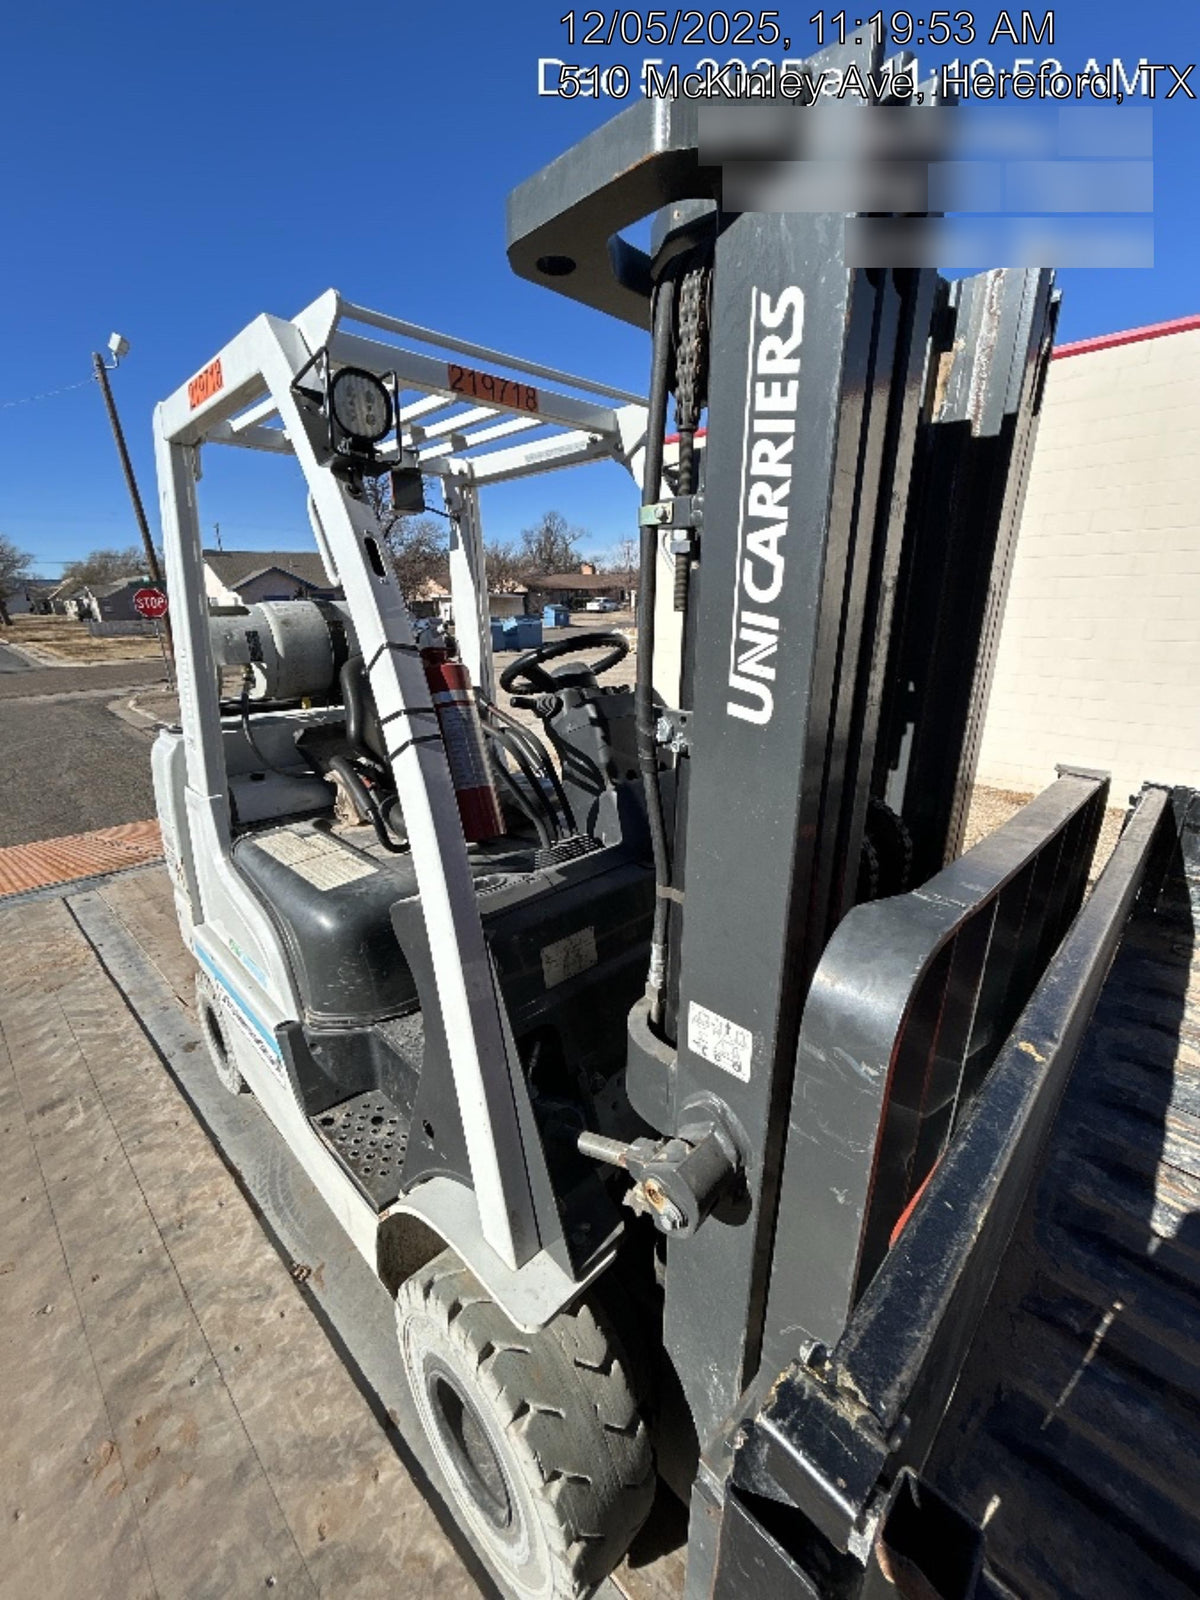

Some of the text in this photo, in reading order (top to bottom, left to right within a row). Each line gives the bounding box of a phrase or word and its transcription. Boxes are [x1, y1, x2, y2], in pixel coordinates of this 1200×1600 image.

[451, 364, 539, 412] 219718
[727, 286, 804, 725] UNICARRIERS
[136, 596, 164, 609] STOP
